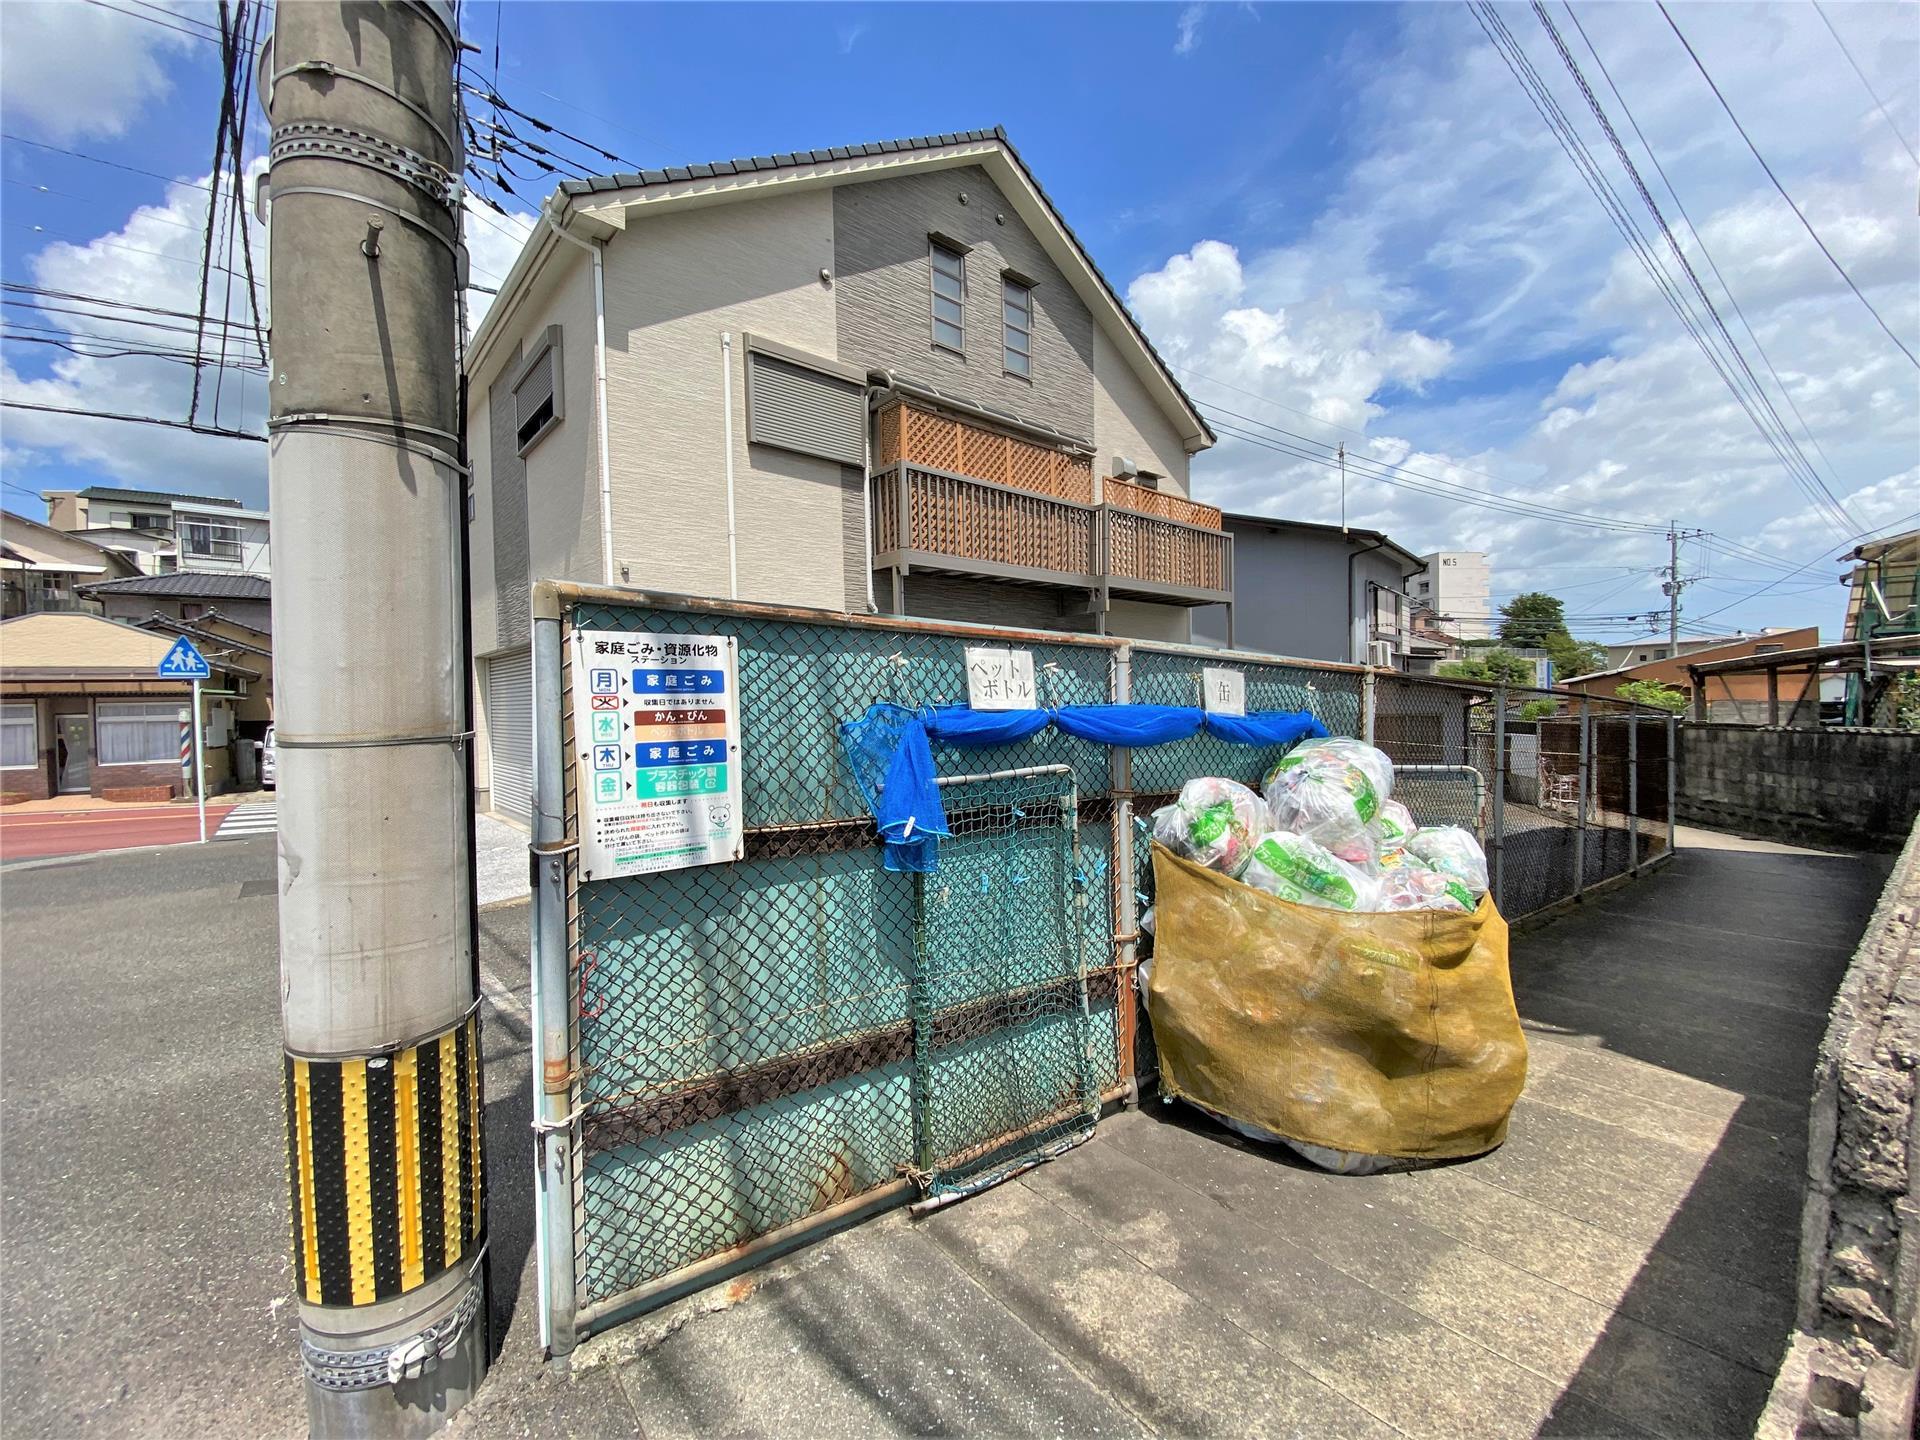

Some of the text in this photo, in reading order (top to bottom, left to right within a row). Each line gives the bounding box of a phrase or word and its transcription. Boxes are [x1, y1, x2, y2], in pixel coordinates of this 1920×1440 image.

[595, 640, 718, 657] 家庭ごみ・資源化物
[631, 655, 687, 665] ステーション
[970, 659, 1021, 680] ペット
[597, 672, 612, 688] 月
[646, 674, 712, 687] 家庭ごみ
[983, 680, 1032, 700] ボトル
[1217, 681, 1231, 703] 缶
[644, 698, 715, 706] 収集日ではありません
[654, 711, 708, 722] かん・びん
[599, 717, 614, 732] 水
[600, 747, 615, 763] 木
[649, 745, 714, 760] 家庭ごみ
[647, 767, 717, 781] プラスチック製
[600, 777, 617, 793] 金
